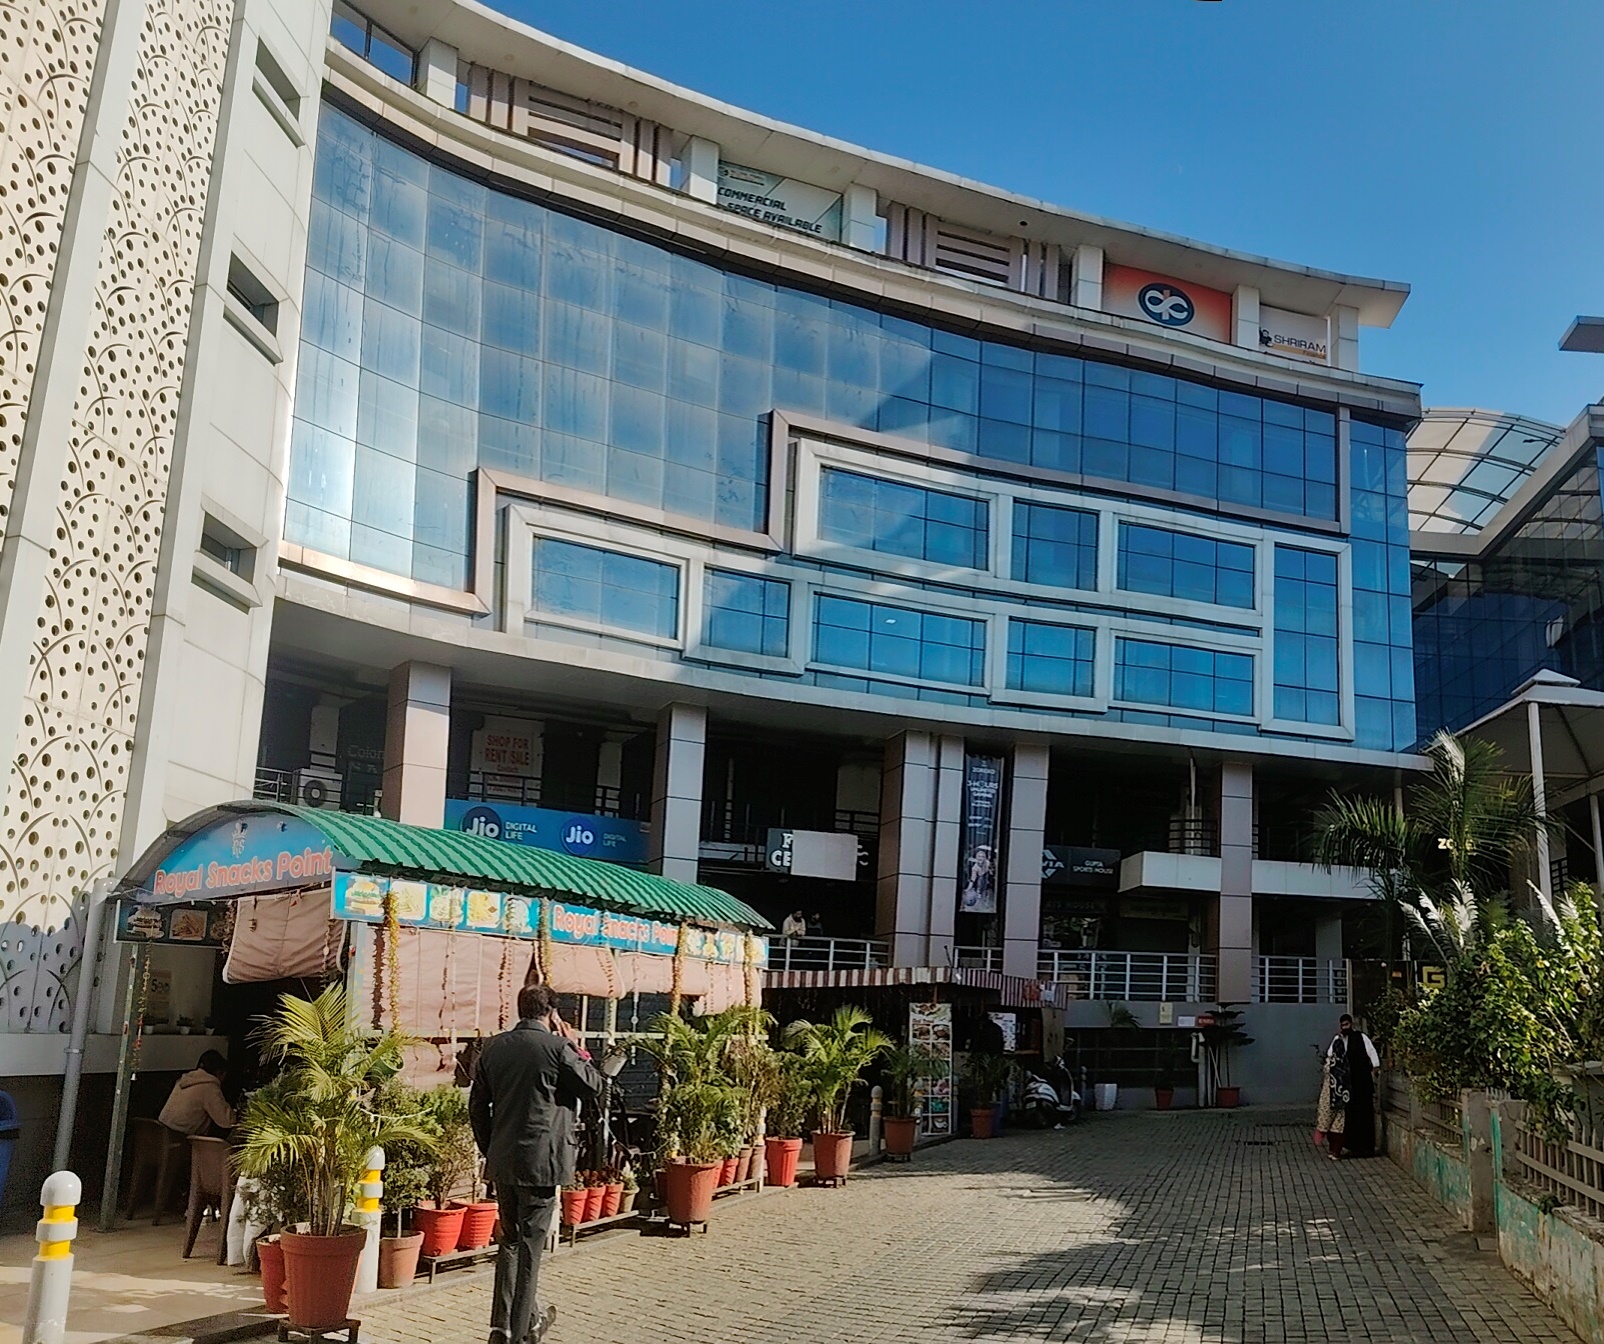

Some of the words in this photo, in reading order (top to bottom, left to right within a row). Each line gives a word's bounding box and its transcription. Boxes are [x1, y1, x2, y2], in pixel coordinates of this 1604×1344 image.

[718, 187, 787, 211] COMMERCIAL
[728, 203, 764, 219] SPACE
[762, 211, 823, 234] AVAILABLE
[1273, 334, 1327, 353] SHRIRAM
[466, 816, 500, 838] Jio
[505, 821, 538, 834] DIGITAL
[505, 830, 524, 841] LIFE
[565, 825, 594, 845] Jio
[603, 832, 627, 843] DIGITAL
[603, 839, 617, 848] LIFE
[153, 863, 204, 898] Royal
[205, 855, 273, 889] Snacks
[276, 845, 333, 880] Point
[553, 904, 600, 939] Royal
[600, 911, 651, 943] Snacks
